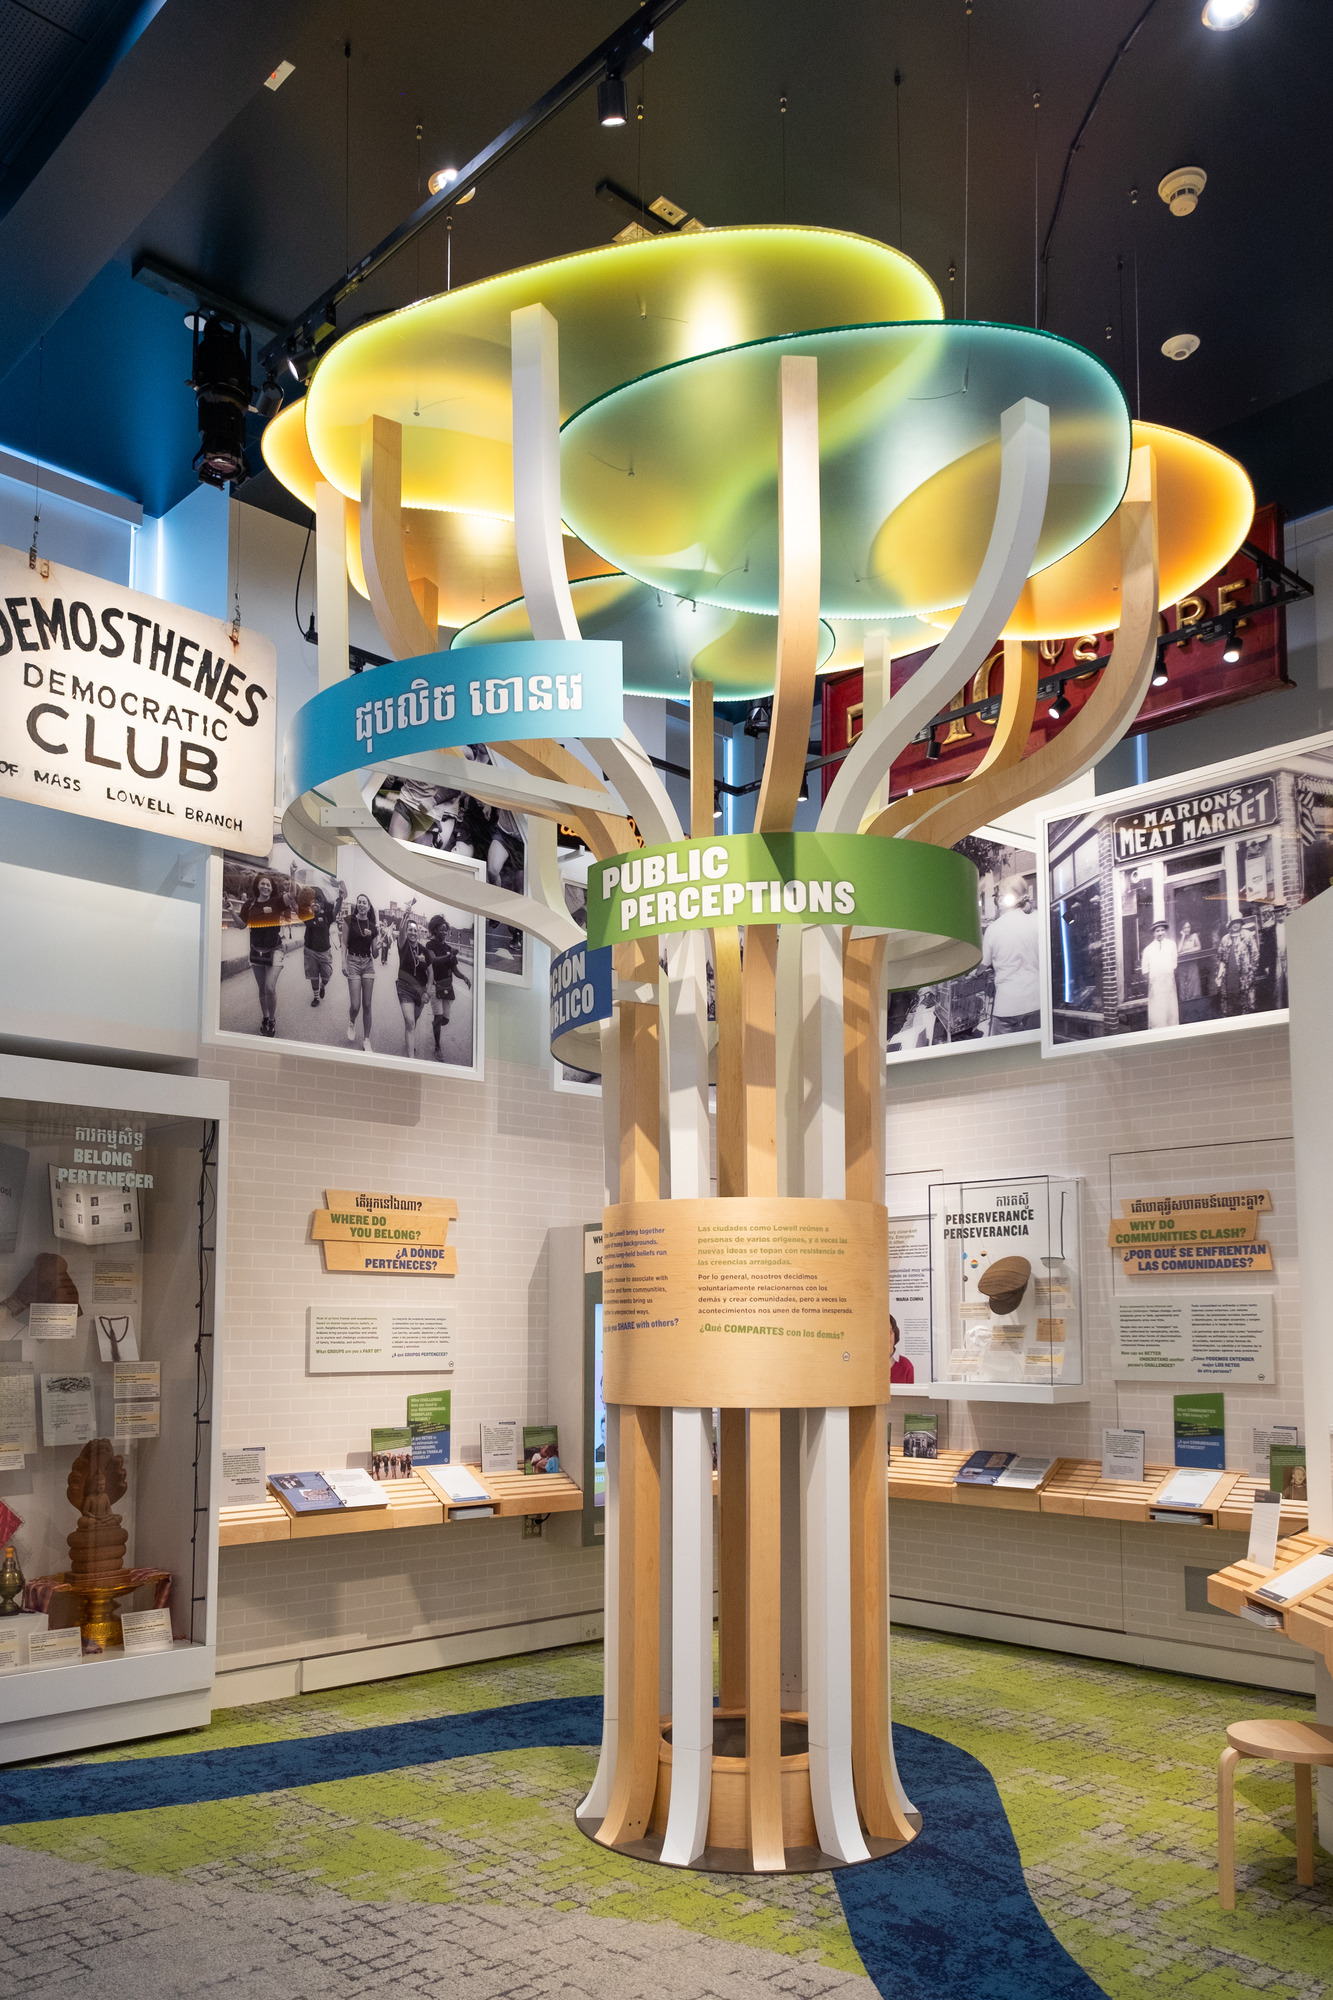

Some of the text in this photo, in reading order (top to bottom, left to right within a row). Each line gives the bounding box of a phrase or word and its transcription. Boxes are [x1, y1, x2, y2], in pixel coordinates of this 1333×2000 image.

[23, 662, 228, 741] DEMOCRATIC
[26, 703, 218, 792] CLUB
[0, 760, 243, 831] OF MASS LOWELL BRANCH
[1119, 787, 1269, 857] MEAT MARKET
[602, 846, 729, 900] PUBLIC
[621, 880, 856, 931] PERCEPTIONS
[74, 1148, 132, 1167] BELONG
[58, 1168, 154, 1189] PERTENECER
[330, 1213, 386, 1226] WHERE DO
[945, 1209, 1034, 1225] PERSERVERANCE
[1130, 1219, 1175, 1231] WHY DO
[350, 1227, 421, 1240] YOU BELONG?
[944, 1224, 1029, 1240] PERSEVERANCIA
[1116, 1227, 1246, 1243] COMMUNITIES CLASH?
[623, 1239, 658, 1247] backgrounds.
[698, 1237, 733, 1245] personas
[395, 1246, 445, 1260] ¿A DÓNDE
[1124, 1244, 1266, 1262] ¿POR QUÉ SE ENFRENTAN
[365, 1259, 437, 1270] PERTENECES?
[1138, 1257, 1253, 1271] LAS COMUNIDADES?
[617, 1322, 635, 1331] SHARE
[636, 1320, 650, 1329] with
[651, 1318, 679, 1327] others?
[699, 1323, 845, 1340] ¿Qué COMPARTES con los demás?
